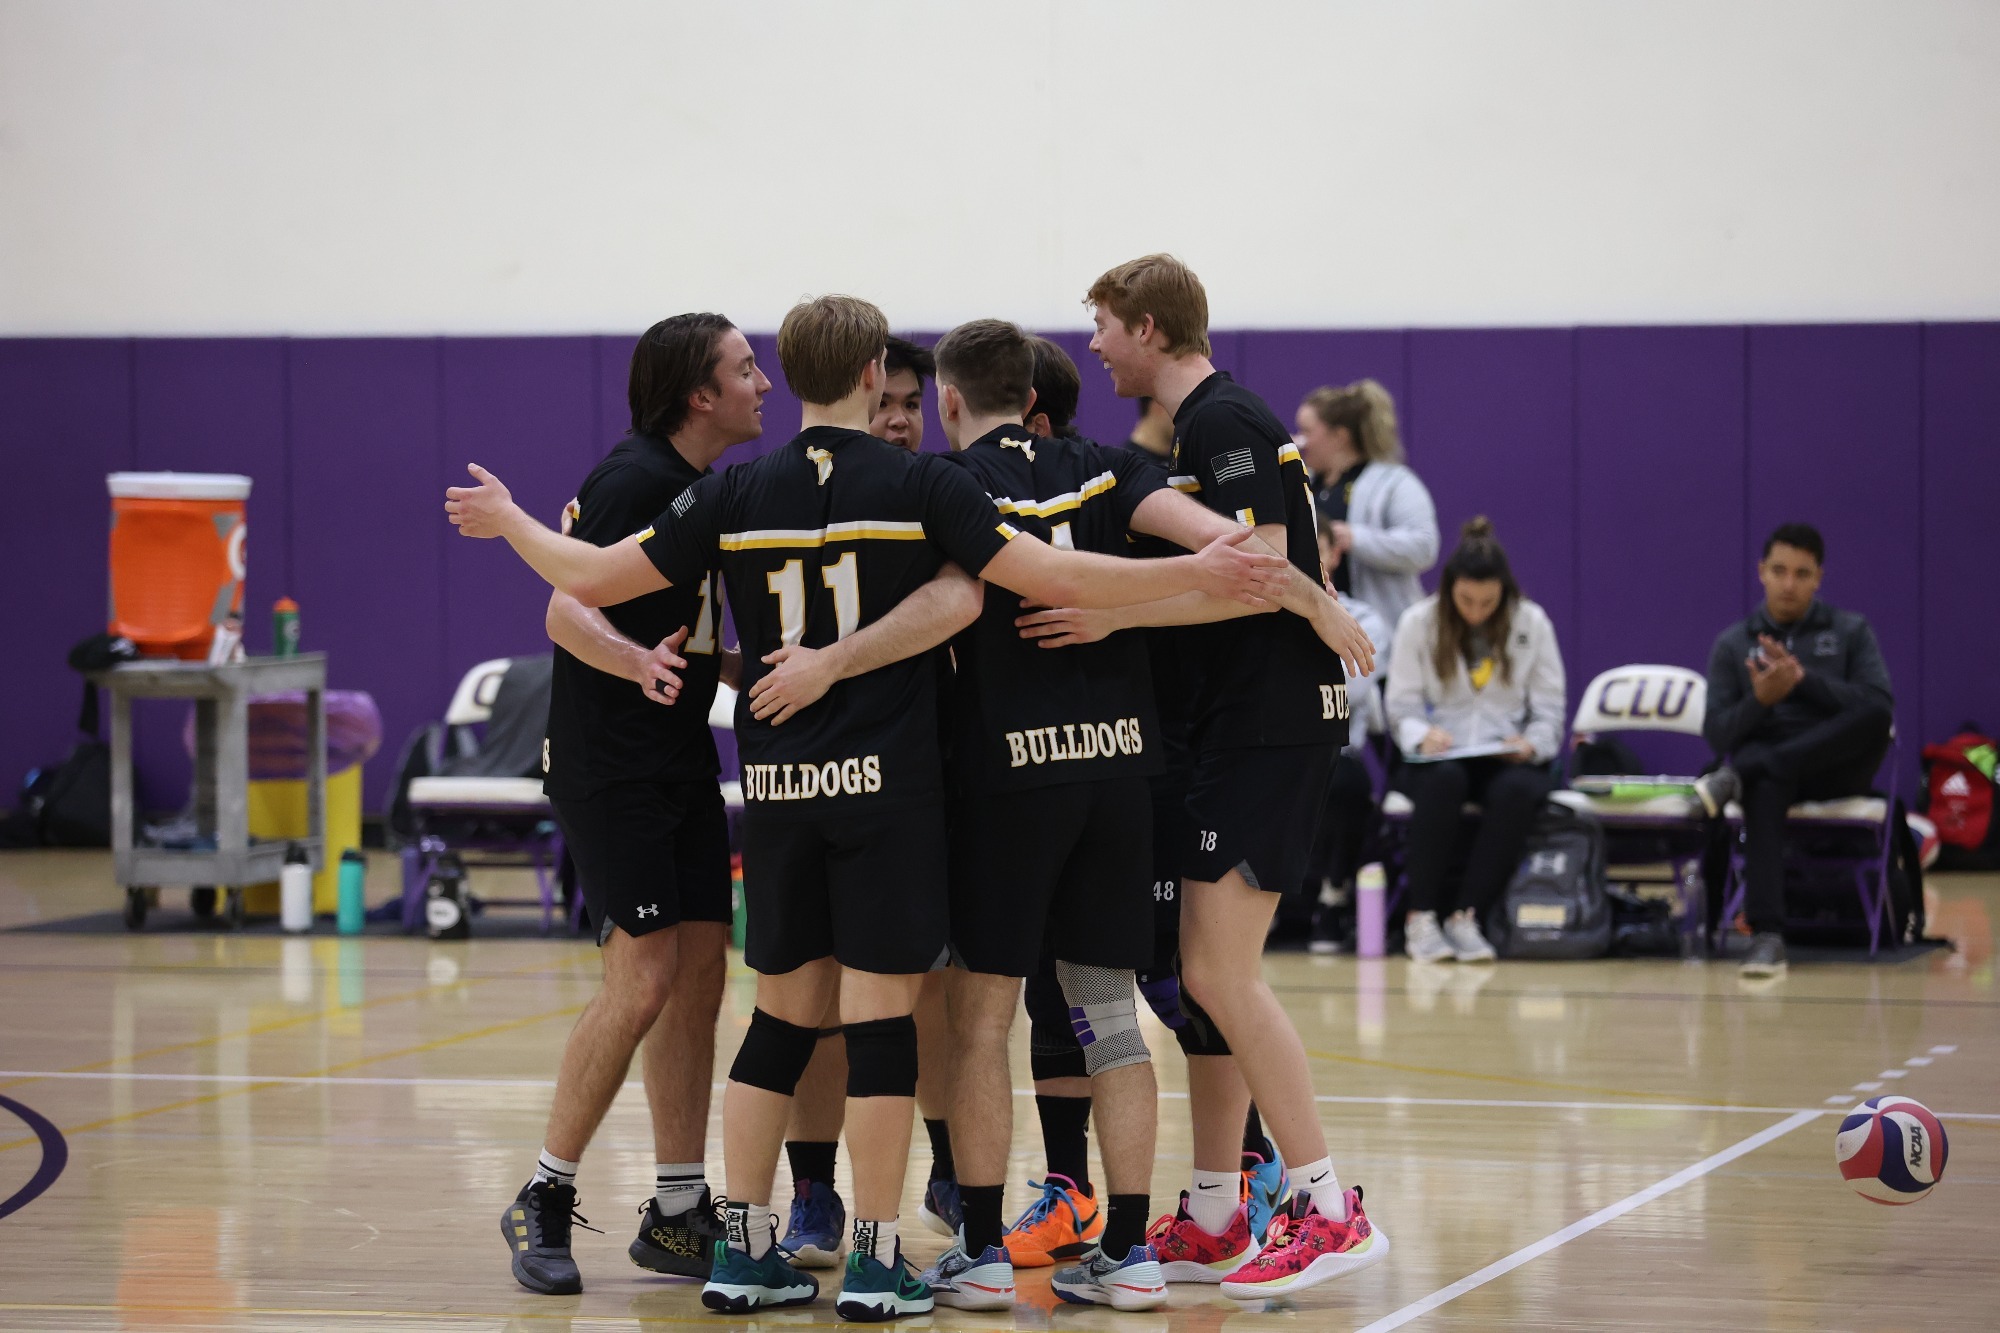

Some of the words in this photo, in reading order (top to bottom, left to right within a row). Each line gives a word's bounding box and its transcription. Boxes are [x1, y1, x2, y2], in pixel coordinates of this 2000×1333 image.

[767, 552, 861, 646] 11
[1598, 678, 1695, 718] CLU
[1005, 718, 1143, 768] BULLDOGS
[744, 755, 882, 802] BULLDOGS
[1200, 830, 1218, 852] 18
[1153, 881, 1175, 902] 48
[1910, 1124, 1923, 1168] NCAA
